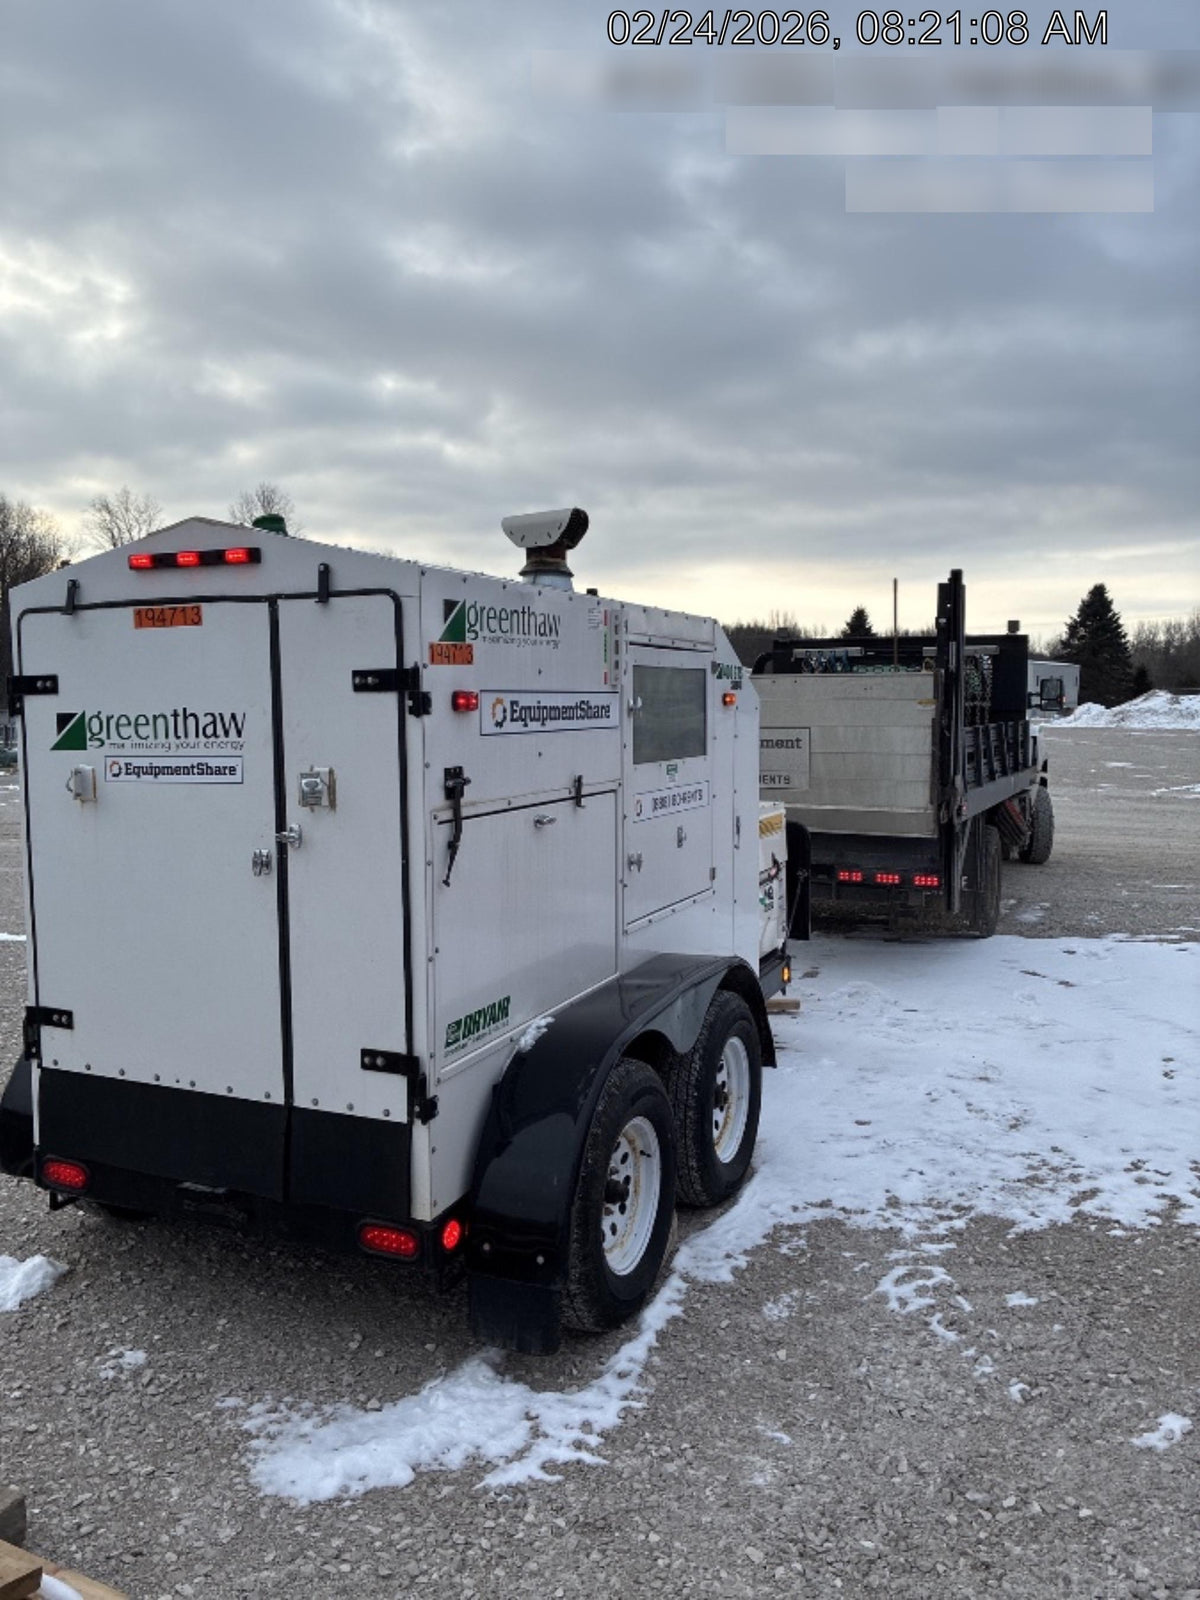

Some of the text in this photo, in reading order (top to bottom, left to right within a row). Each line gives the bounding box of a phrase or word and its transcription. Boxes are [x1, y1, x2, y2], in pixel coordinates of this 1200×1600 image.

[135, 607, 201, 628] 194713
[467, 600, 561, 641] greenthaw
[509, 700, 611, 727] EquipmentShare
[87, 707, 246, 748] greenthaw
[124, 762, 237, 778] EquipmentShare
